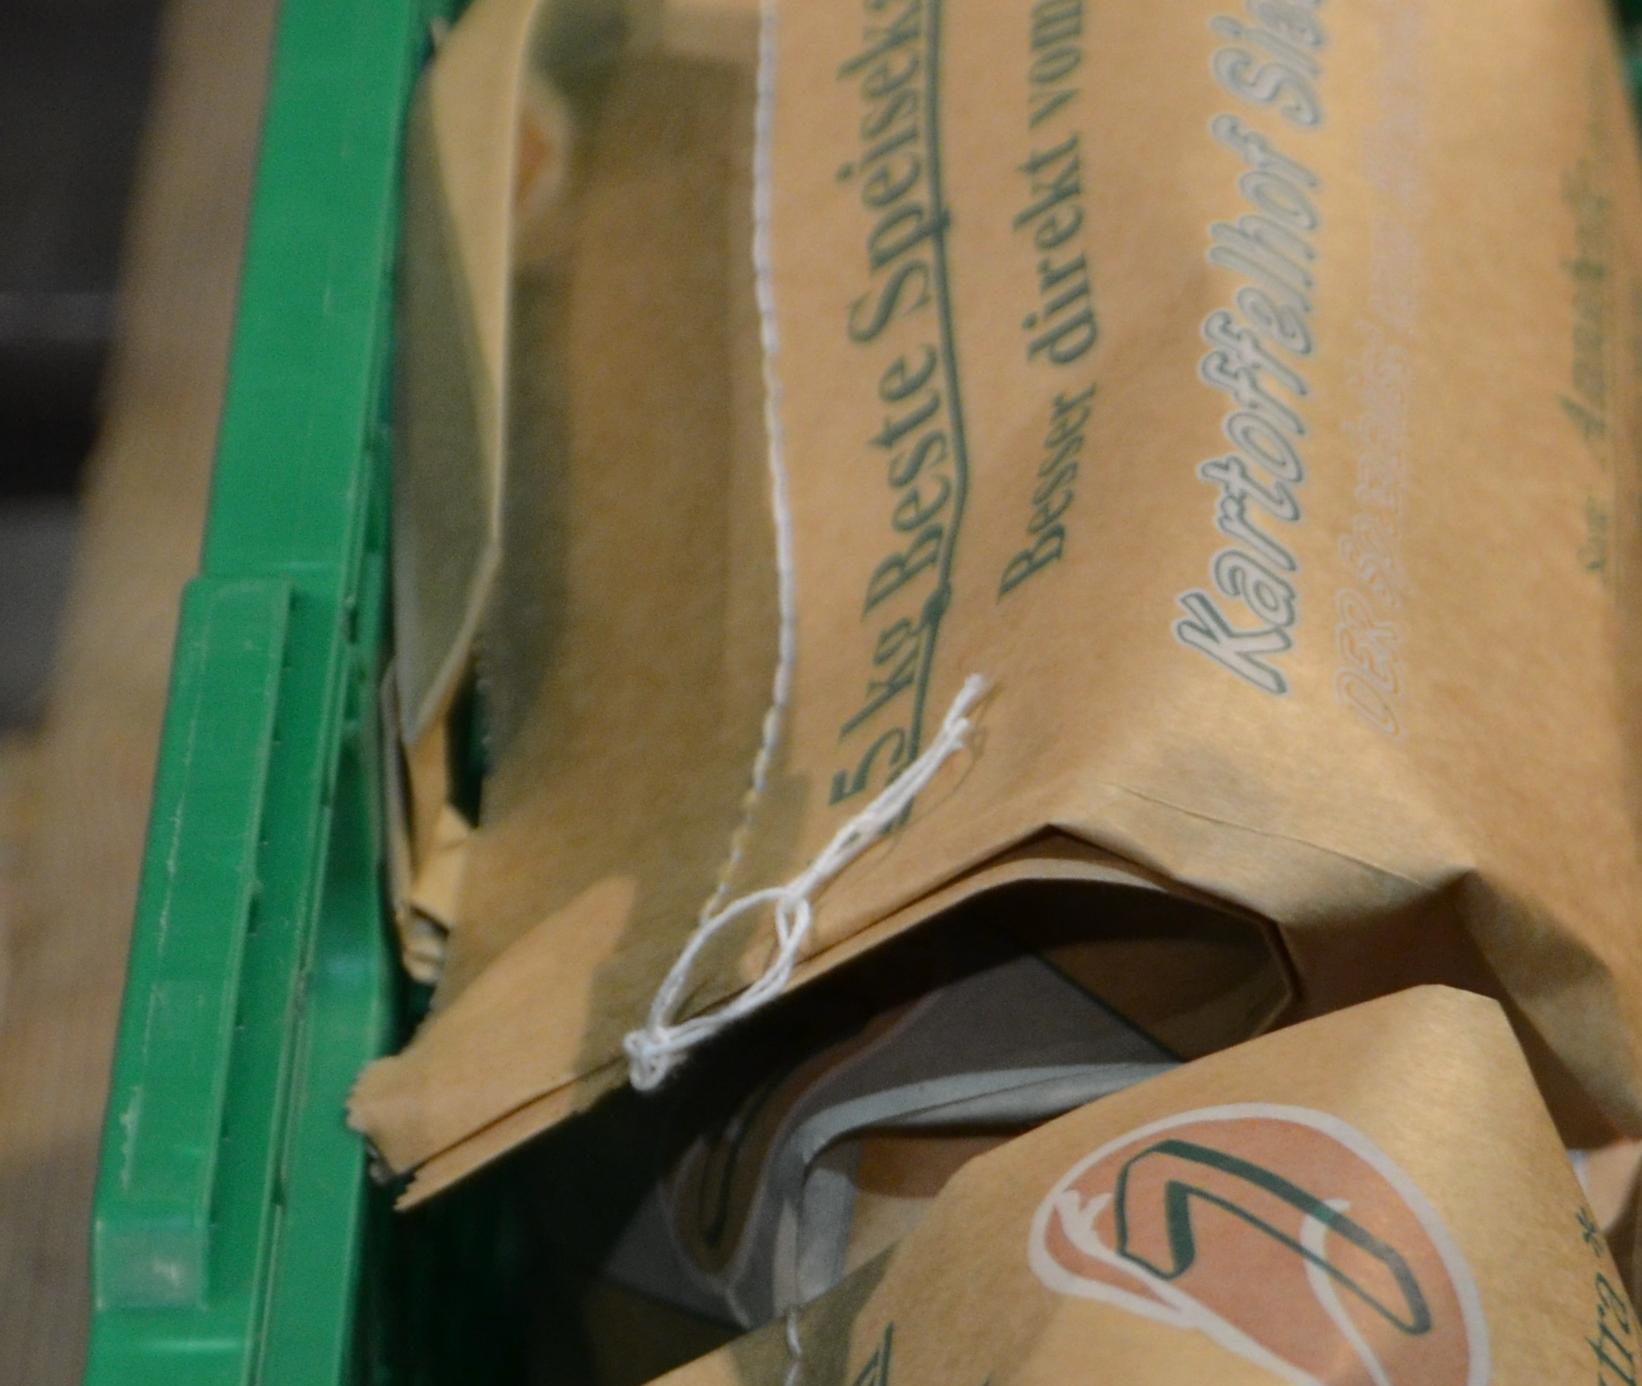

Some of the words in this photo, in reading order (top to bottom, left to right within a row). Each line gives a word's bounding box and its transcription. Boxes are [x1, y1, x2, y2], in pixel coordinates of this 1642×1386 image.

[834, 0, 952, 348] Speisek
[1206, 0, 1326, 128] Sie
[1010, 132, 1098, 366] direkt
[857, 342, 952, 623] Beste
[995, 382, 1097, 606] Besser
[1172, 112, 1322, 696] Kartoffelhof
